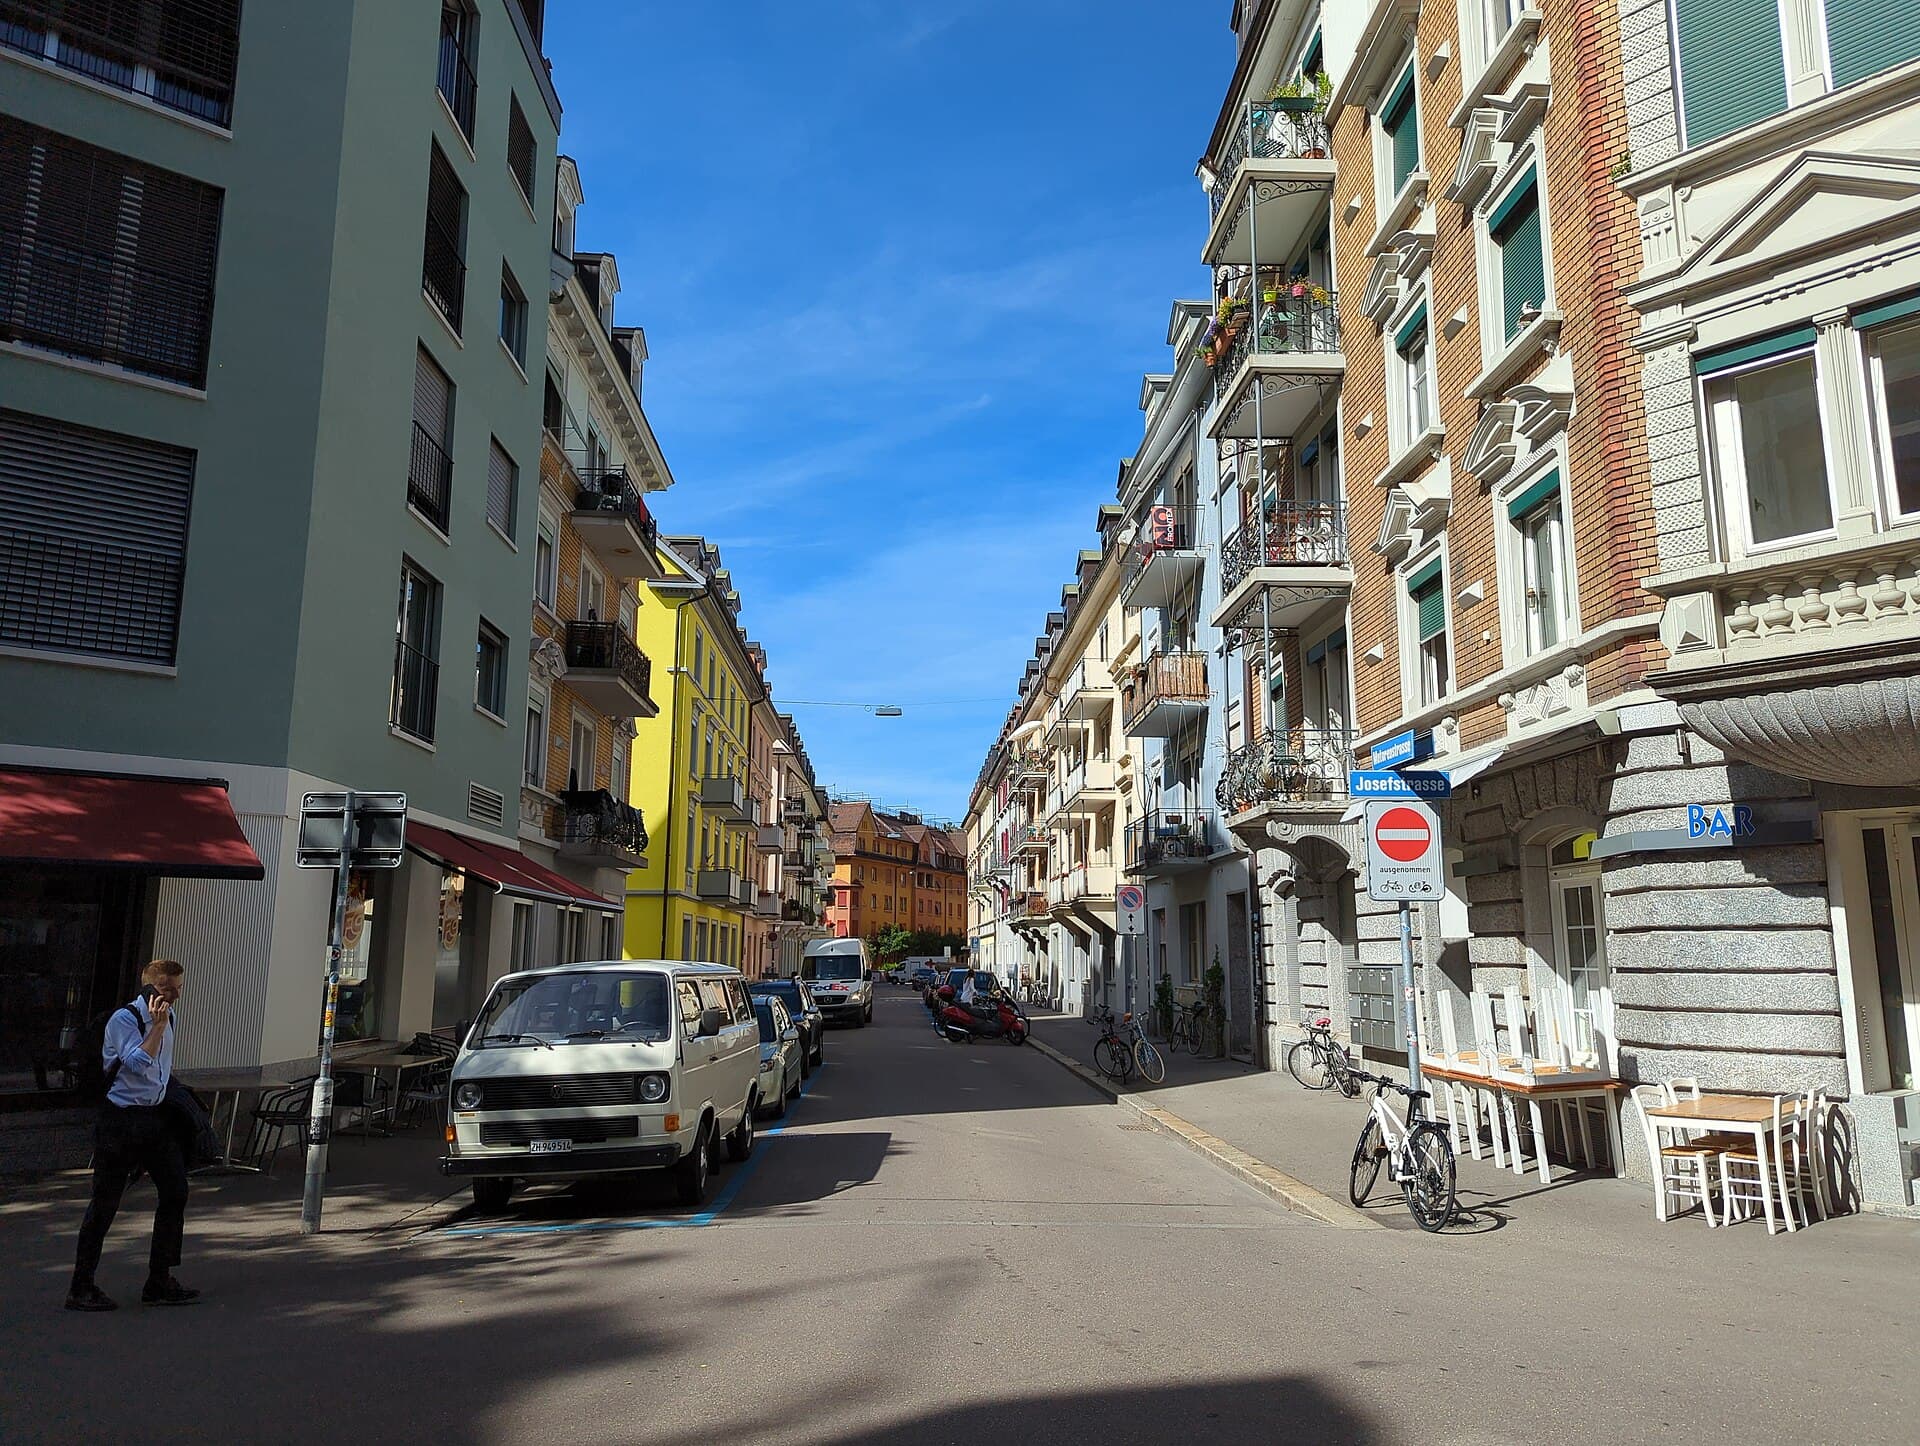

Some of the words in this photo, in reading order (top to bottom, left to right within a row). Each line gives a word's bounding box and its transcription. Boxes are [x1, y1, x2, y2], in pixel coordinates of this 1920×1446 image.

[1355, 775, 1445, 792] Josefstrasse
[1686, 803, 1756, 839] BAR
[1379, 866, 1431, 875] ausgenommen
[808, 983, 849, 991] FedEx
